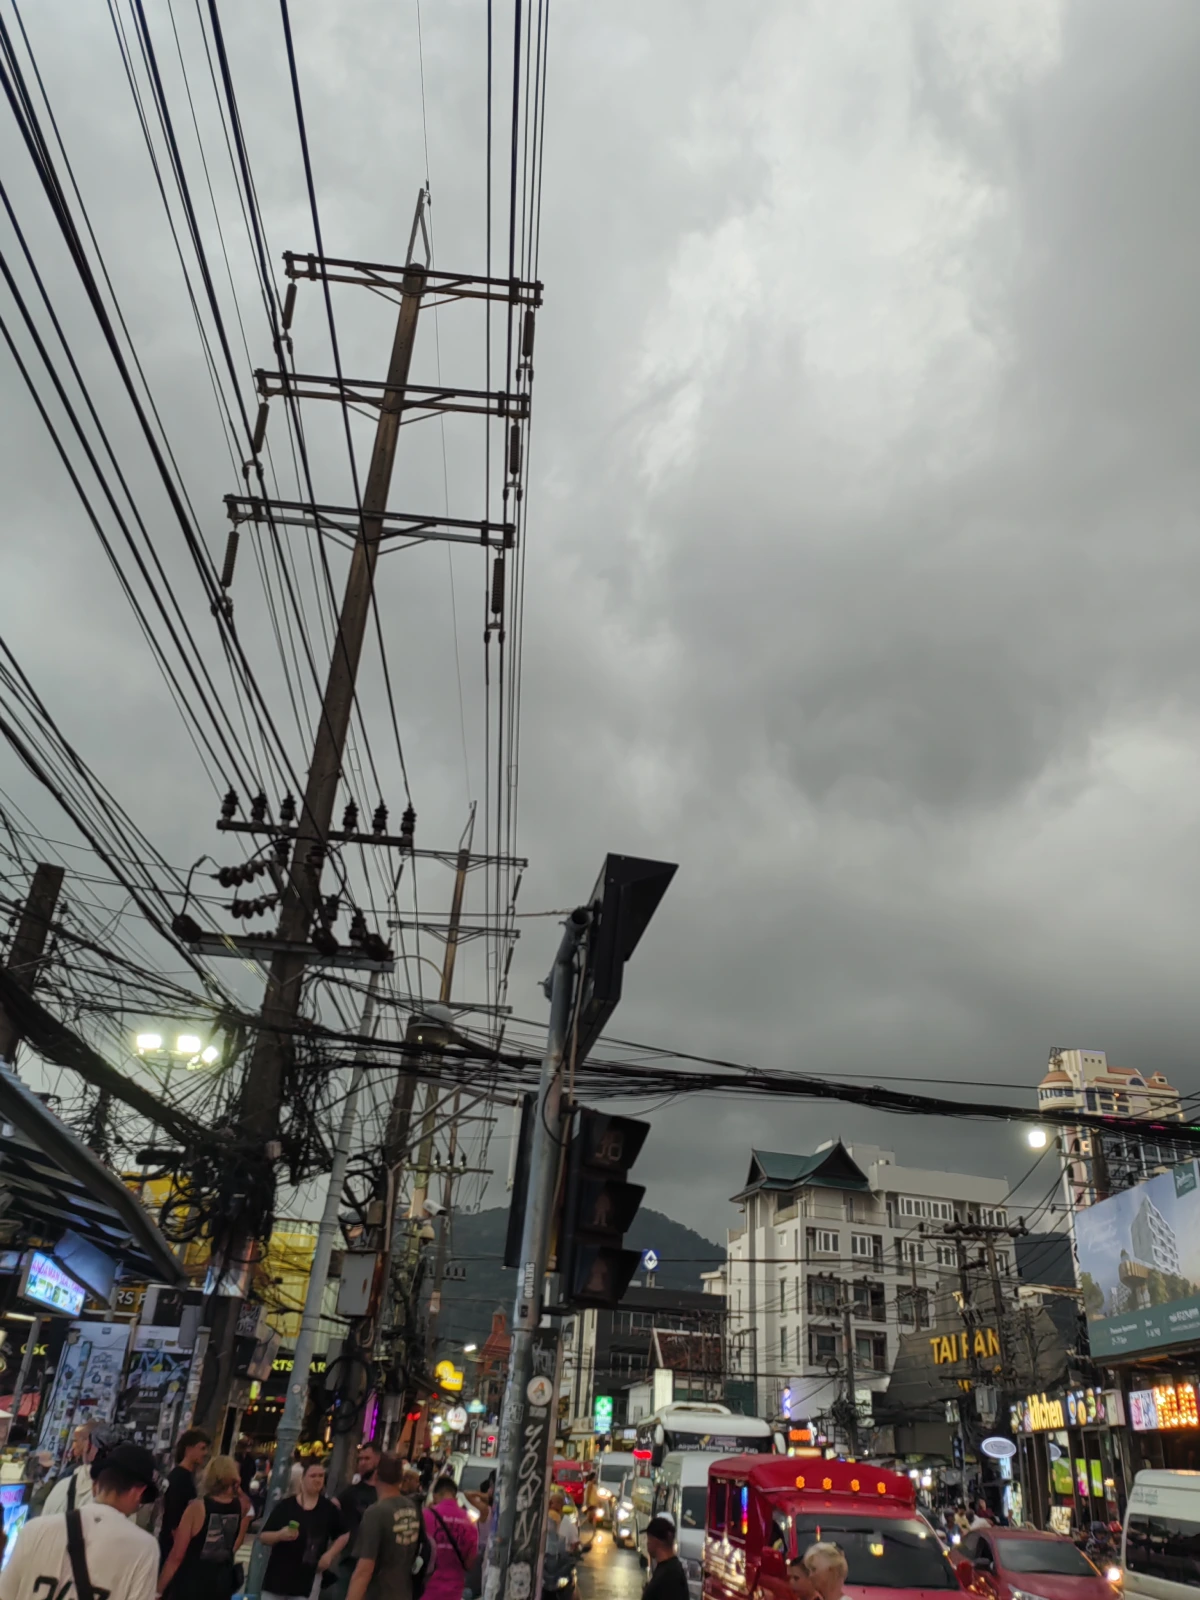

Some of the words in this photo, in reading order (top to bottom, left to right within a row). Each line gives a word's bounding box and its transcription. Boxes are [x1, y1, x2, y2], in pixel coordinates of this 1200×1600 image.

[930, 1333, 957, 1364] TAI
[271, 1359, 294, 1372] RTS
[1027, 1392, 1064, 1431] kitchen
[678, 1443, 700, 1451] Airport
